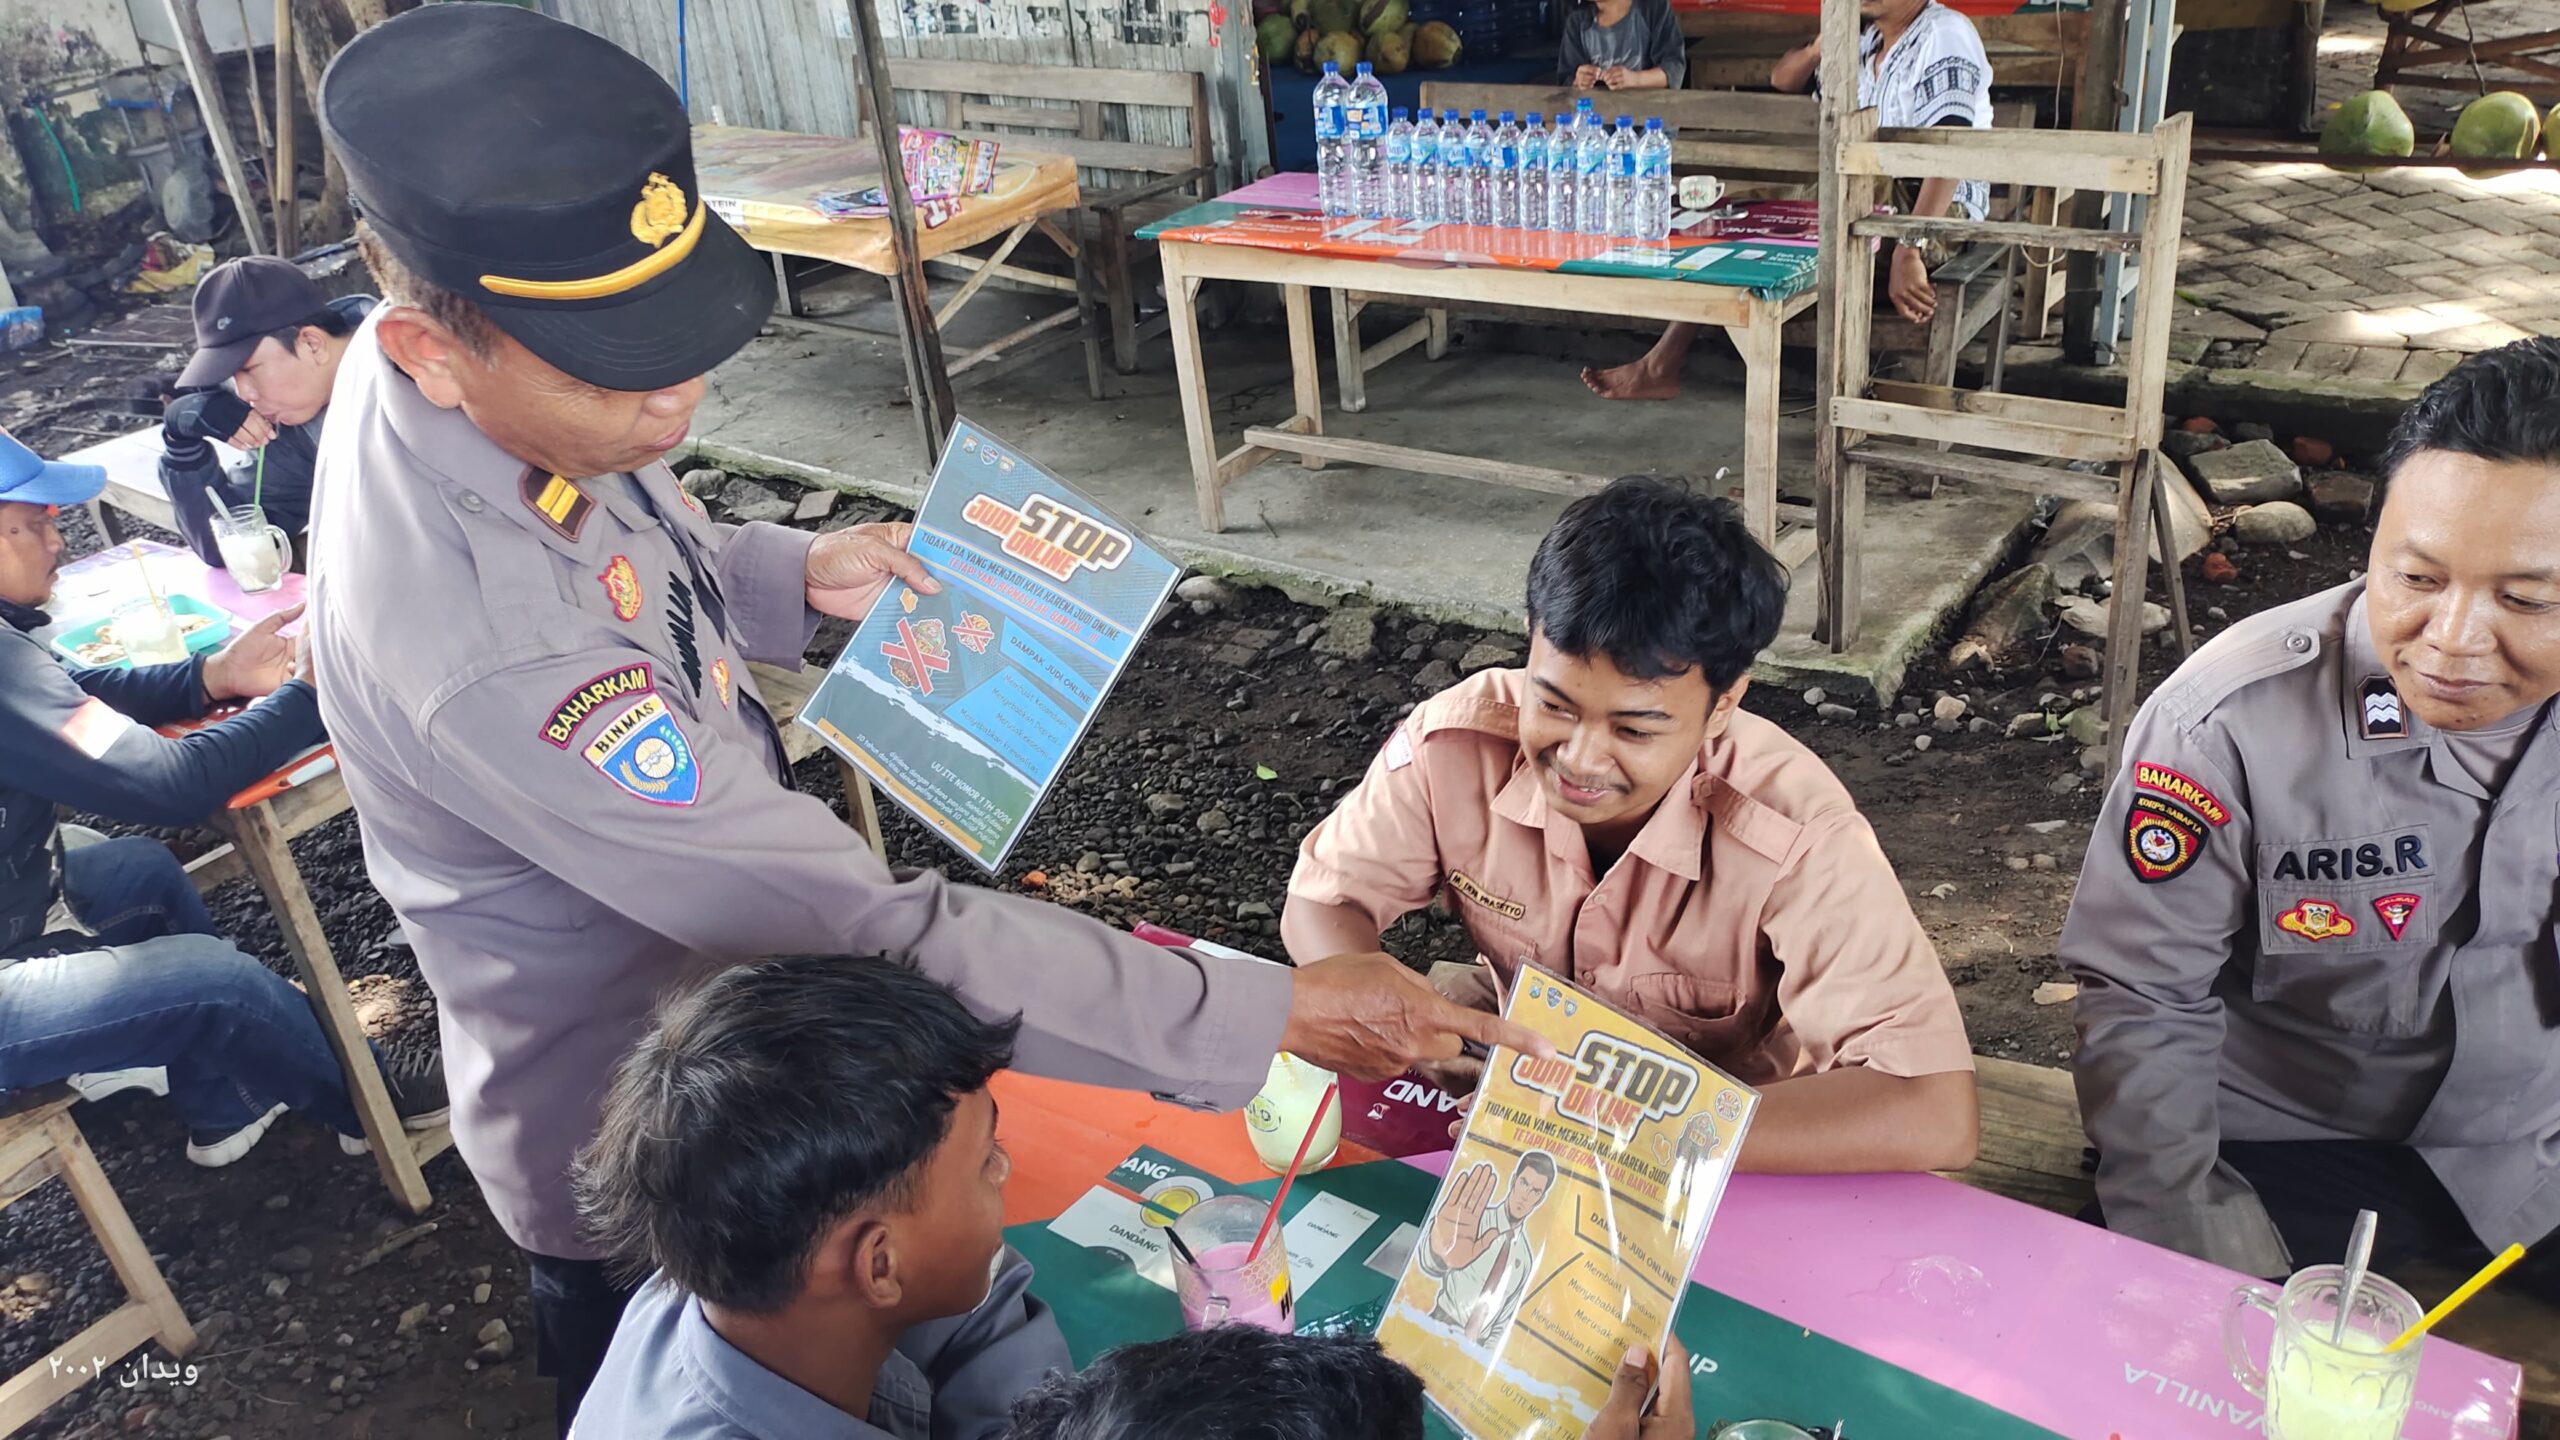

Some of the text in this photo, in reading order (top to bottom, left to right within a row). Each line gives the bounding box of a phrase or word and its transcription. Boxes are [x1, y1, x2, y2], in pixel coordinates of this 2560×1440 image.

[966, 499, 1020, 534] JUDI
[1019, 501, 1127, 564] STOP
[1006, 528, 1078, 578] ONLINE
[921, 531, 947, 551] TIDAK
[946, 541, 966, 559] ADA
[964, 550, 989, 569] YANG
[986, 561, 1024, 588] MENJADI
[1021, 579, 1045, 598] KAYA
[1042, 591, 1075, 614] KARENA
[1071, 607, 1094, 626] JUDI
[1090, 619, 1119, 640] ONLINE
[974, 569, 999, 588] YANG
[1010, 636, 1092, 705] DAMPAK JUDI ONLINE
[548, 668, 649, 742] BAHARKAM
[594, 702, 655, 754] BINMAS
[929, 760, 944, 773] UU
[941, 768, 956, 782] ITE
[954, 779, 979, 799] NOMOR
[982, 800, 995, 811] TH
[992, 808, 1012, 825] 2024
[2139, 766, 2224, 823] BAHARKAM
[2273, 835, 2428, 882] ARIS.R
[1517, 1056, 1575, 1091] JUDI
[1576, 1041, 1691, 1111] STOP
[1563, 1083, 1641, 1131] ONLINE
[1485, 1101, 1513, 1122] TIDAK
[1512, 1109, 1532, 1127] ADA
[1533, 1117, 1557, 1136] YANG
[1617, 1150, 1649, 1177] KARENA
[1648, 1165, 1671, 1187] JUDI
[1512, 1128, 1544, 1150] TETAPI
[1543, 1141, 1567, 1158] YANG
[1565, 1150, 1625, 1183] BERMAALAH,
[1109, 1224, 1161, 1253] DANDANG
[1584, 1260, 1623, 1293] Membuat
[1629, 1241, 1647, 1265] JUDI
[1646, 1256, 1678, 1289] ONLINE
[1531, 1308, 1585, 1350] Menyebabkan
[1574, 1309, 1613, 1340] Merusak
[1498, 1383, 1514, 1398] UU
[2123, 1361, 2266, 1438] VANILLA
